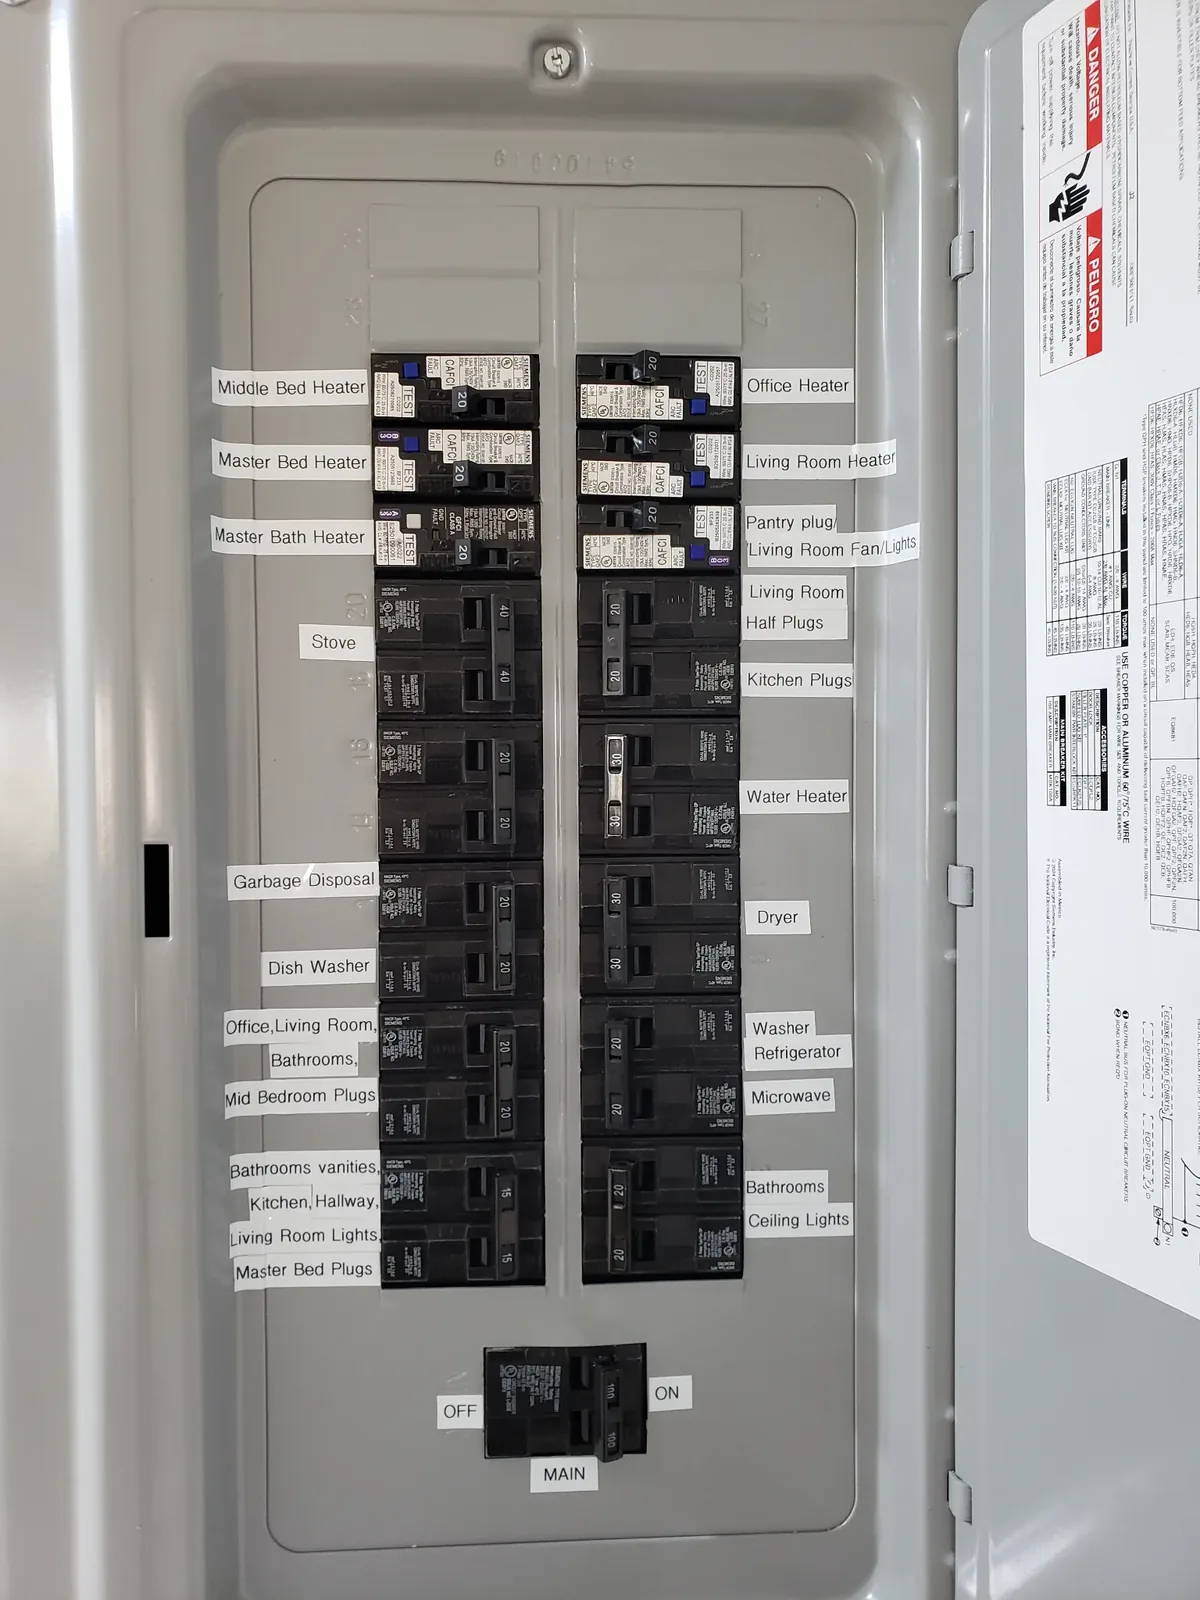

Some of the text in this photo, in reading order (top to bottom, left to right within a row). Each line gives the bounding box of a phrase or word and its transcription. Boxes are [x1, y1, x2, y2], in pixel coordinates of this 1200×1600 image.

[1088, 47, 1099, 121] DANGER
[1089, 258, 1099, 332] PELIGRO
[649, 356, 657, 370] 20
[445, 360, 455, 386] CAFCI
[697, 363, 706, 391] TEST
[218, 379, 366, 396] Middle Bed Heater
[747, 378, 850, 393] Office Heater
[403, 388, 413, 416] TEST
[458, 392, 467, 407] 20
[655, 389, 664, 416] CAFCI
[649, 431, 657, 445] 20
[448, 434, 456, 460] CAFCI
[696, 436, 705, 464] TEST
[219, 451, 367, 470] Master Bed Heater
[747, 453, 895, 471] Living Room Heater
[404, 462, 413, 490] TEST
[455, 466, 464, 481] 20
[655, 466, 665, 493] CAFCI
[648, 507, 657, 522] 20
[696, 507, 705, 536] TEST
[746, 515, 837, 531] Pantry plug/
[215, 526, 365, 545] Master Bath Heater
[406, 535, 414, 564] TEST
[459, 545, 467, 560] 20
[658, 538, 667, 565] CAFCI
[801, 543, 844, 556] Room
[852, 537, 916, 556] Fan/Lights
[750, 584, 794, 602] Living
[801, 584, 844, 599] Room
[500, 605, 509, 617] 40
[611, 604, 620, 615] 20
[746, 615, 824, 632] Half Plugs
[312, 633, 356, 650] Stove
[1121, 652, 1129, 669] USE
[500, 671, 510, 682] 40
[611, 671, 620, 681] 20
[747, 672, 852, 690] Kitchen Plugs
[1122, 714, 1129, 726] OR
[499, 751, 510, 764] 20
[612, 753, 622, 765] 30
[746, 789, 848, 804] Water Heater
[499, 817, 510, 829] 20
[610, 816, 621, 828] 30
[233, 871, 375, 890] Garbage Disposal
[499, 896, 509, 908] 20
[612, 893, 622, 904] 30
[757, 910, 799, 927] Dryer
[269, 959, 370, 975] Dish Washer
[500, 961, 511, 974] 20
[611, 957, 621, 969] 30
[328, 1017, 377, 1033] Room,
[752, 1021, 810, 1036] Washer
[500, 1041, 510, 1053] 20
[611, 1038, 621, 1049] 20
[271, 1052, 358, 1068] Bathrooms,
[754, 1045, 841, 1062] Refrigerator
[225, 1088, 376, 1108] Mid Bedroom Plugs
[751, 1090, 831, 1104] Microwave
[501, 1106, 511, 1119] 20
[612, 1103, 621, 1116] 20
[230, 1160, 380, 1179] Bathrooms vanities,
[502, 1188, 511, 1198] 15
[614, 1184, 624, 1196] 20
[746, 1180, 825, 1194] Bathrooms
[251, 1196, 312, 1211] Kitchen,
[316, 1194, 379, 1209] Hallway,
[748, 1212, 850, 1229] Ceiling Lights
[231, 1231, 272, 1247] Living
[281, 1229, 324, 1242] Room
[502, 1252, 512, 1263] 15
[614, 1248, 624, 1261] 20
[236, 1262, 372, 1280] Master Bed Plugs
[654, 1385, 679, 1401] ON
[443, 1404, 477, 1419] OFF
[544, 1466, 585, 1482] MAIN
